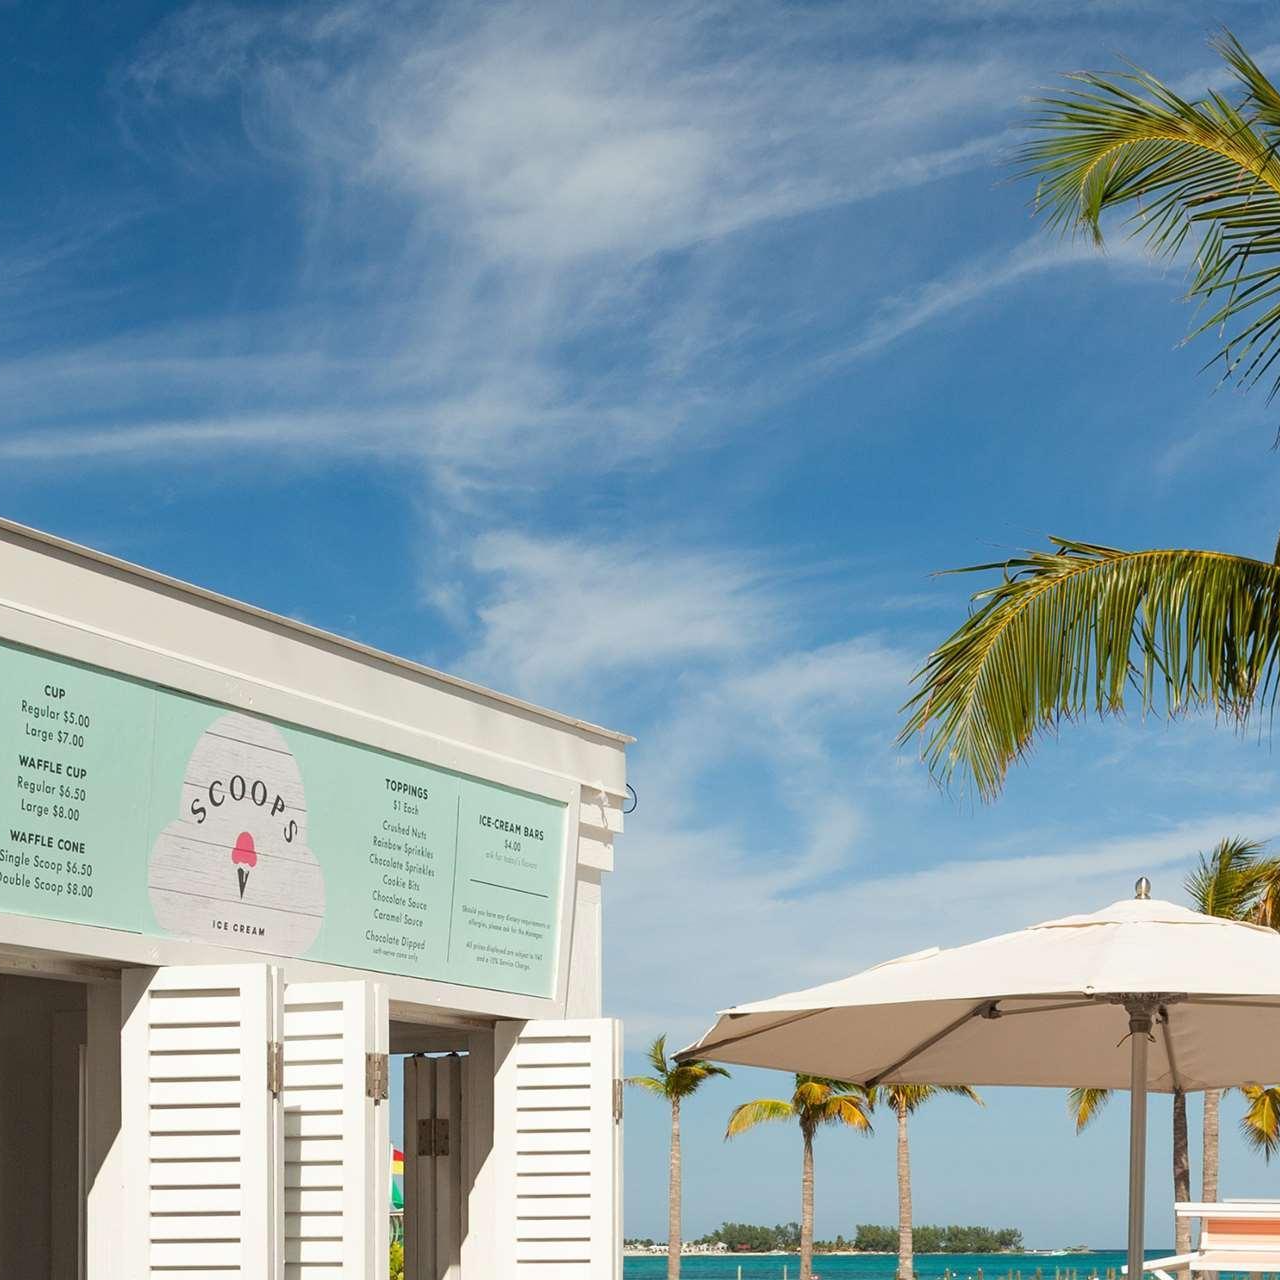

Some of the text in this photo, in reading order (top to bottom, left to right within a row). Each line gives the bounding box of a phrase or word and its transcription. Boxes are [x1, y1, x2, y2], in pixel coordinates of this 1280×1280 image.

[44, 685, 66, 699] CUP
[21, 700, 90, 728] Regular $5.00
[25, 722, 84, 748] Large $7.00
[18, 754, 87, 779] WAFFLE CUP
[17, 775, 86, 801] Regular $6.50
[385, 778, 428, 800] TOPPINGS
[21, 798, 80, 821] Large $8.00
[190, 774, 298, 843] SCOOPS
[393, 800, 419, 815] $1 Each
[382, 820, 427, 840] Crushed Nuts
[479, 814, 544, 841] ICE-CREAM BARS
[10, 829, 86, 854] WAFFLE CONE
[373, 835, 434, 859] Rainbow Sprinkles
[0, 849, 93, 877] Single Scoop $6.50
[369, 853, 435, 877] Chocolate Sprinkles
[34, 877, 63, 896] Scoop
[66, 882, 93, 898] $8.00
[382, 874, 420, 891] Cookie Bits
[372, 890, 427, 911] Chocolate Sauce
[212, 919, 266, 936] ICE CREAM
[374, 908, 424, 927] Caramel Sauce
[365, 930, 426, 951] Chocolate Dipped
